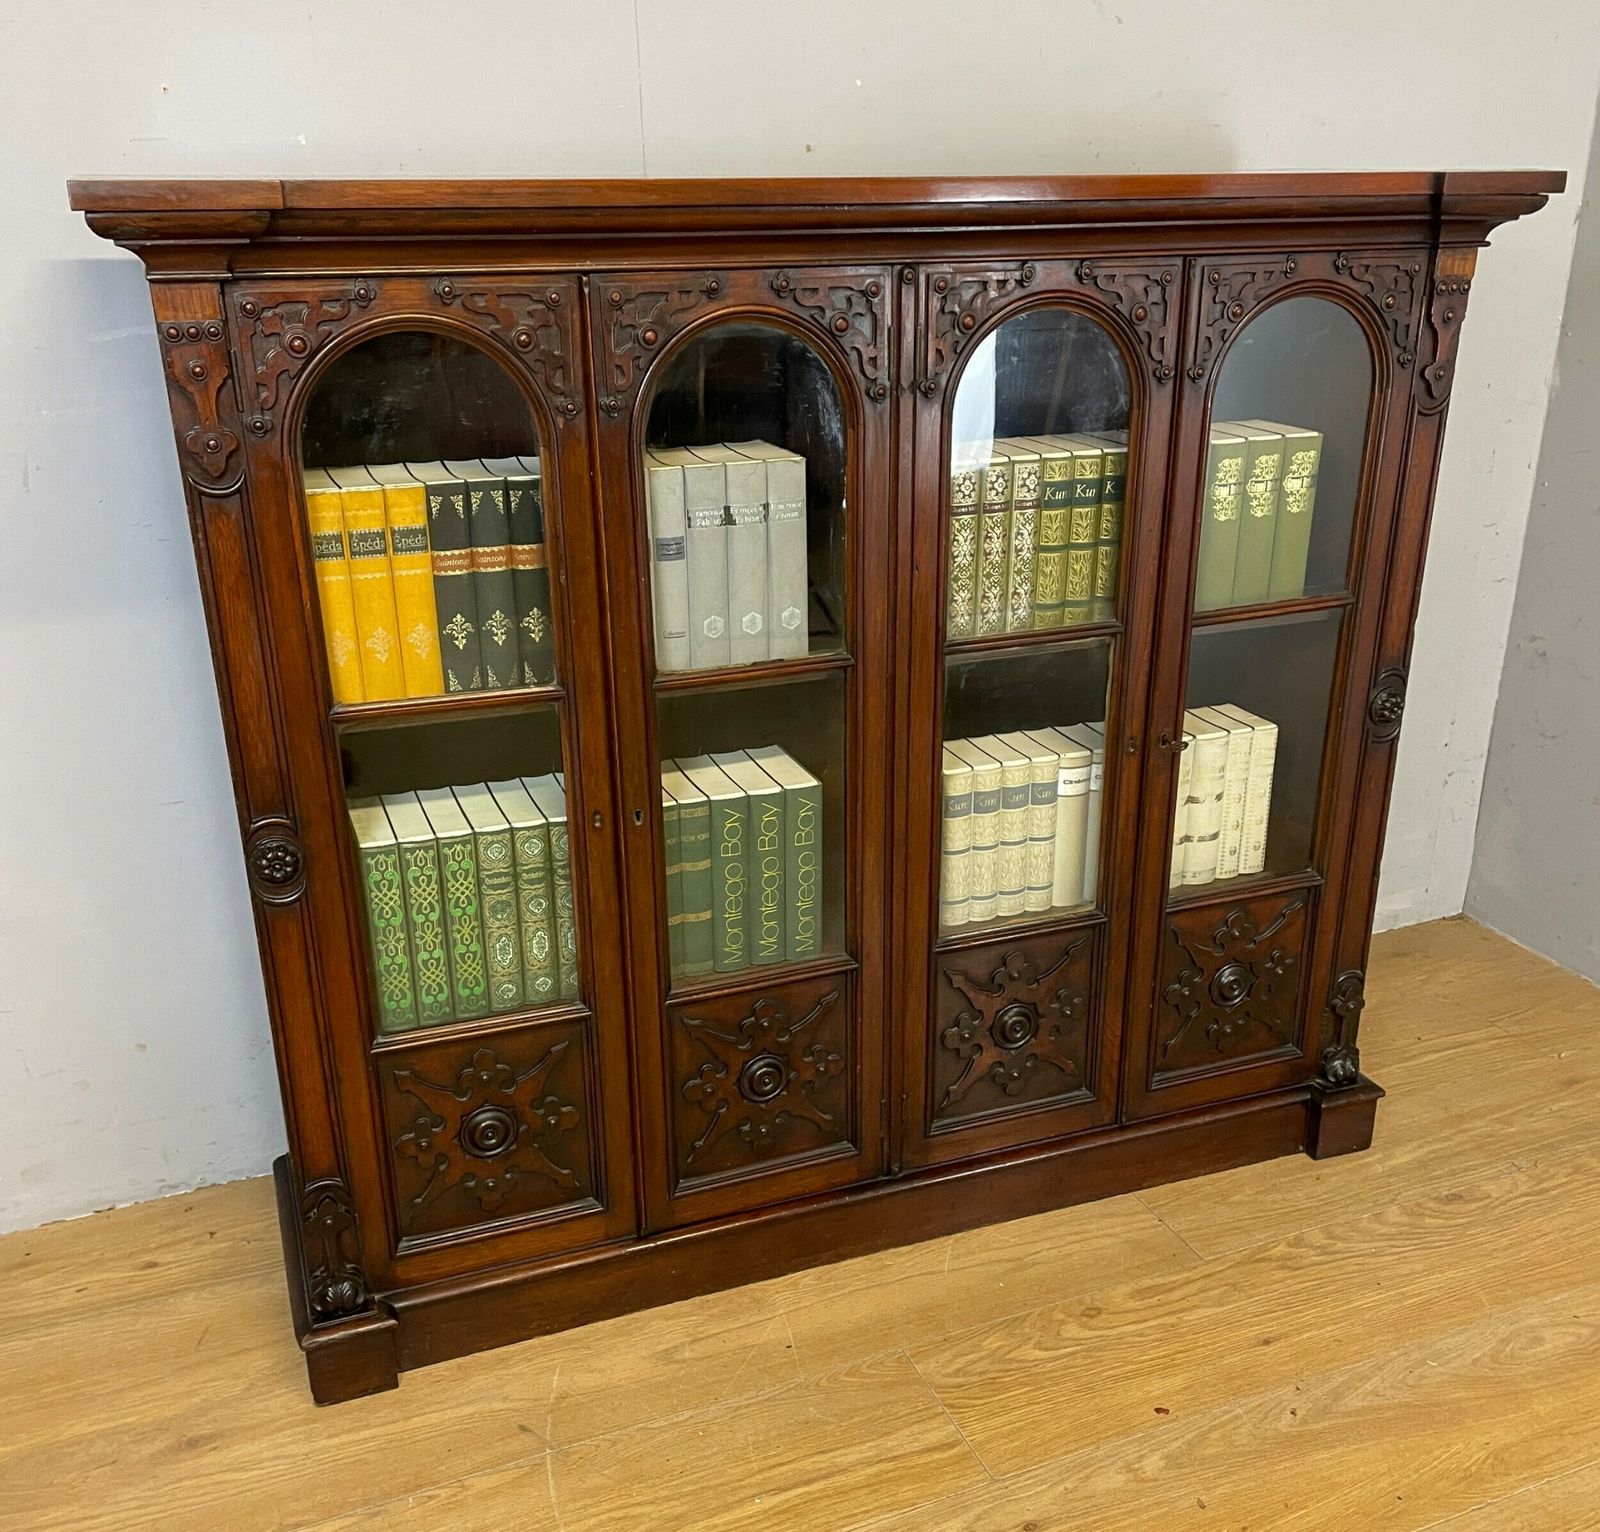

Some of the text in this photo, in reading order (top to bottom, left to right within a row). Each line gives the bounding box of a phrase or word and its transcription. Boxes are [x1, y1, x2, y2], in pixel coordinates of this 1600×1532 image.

[720, 808, 748, 964] Montego Bay
[757, 802, 784, 957] Montego Bay
[794, 797, 820, 952] Montego Bay
